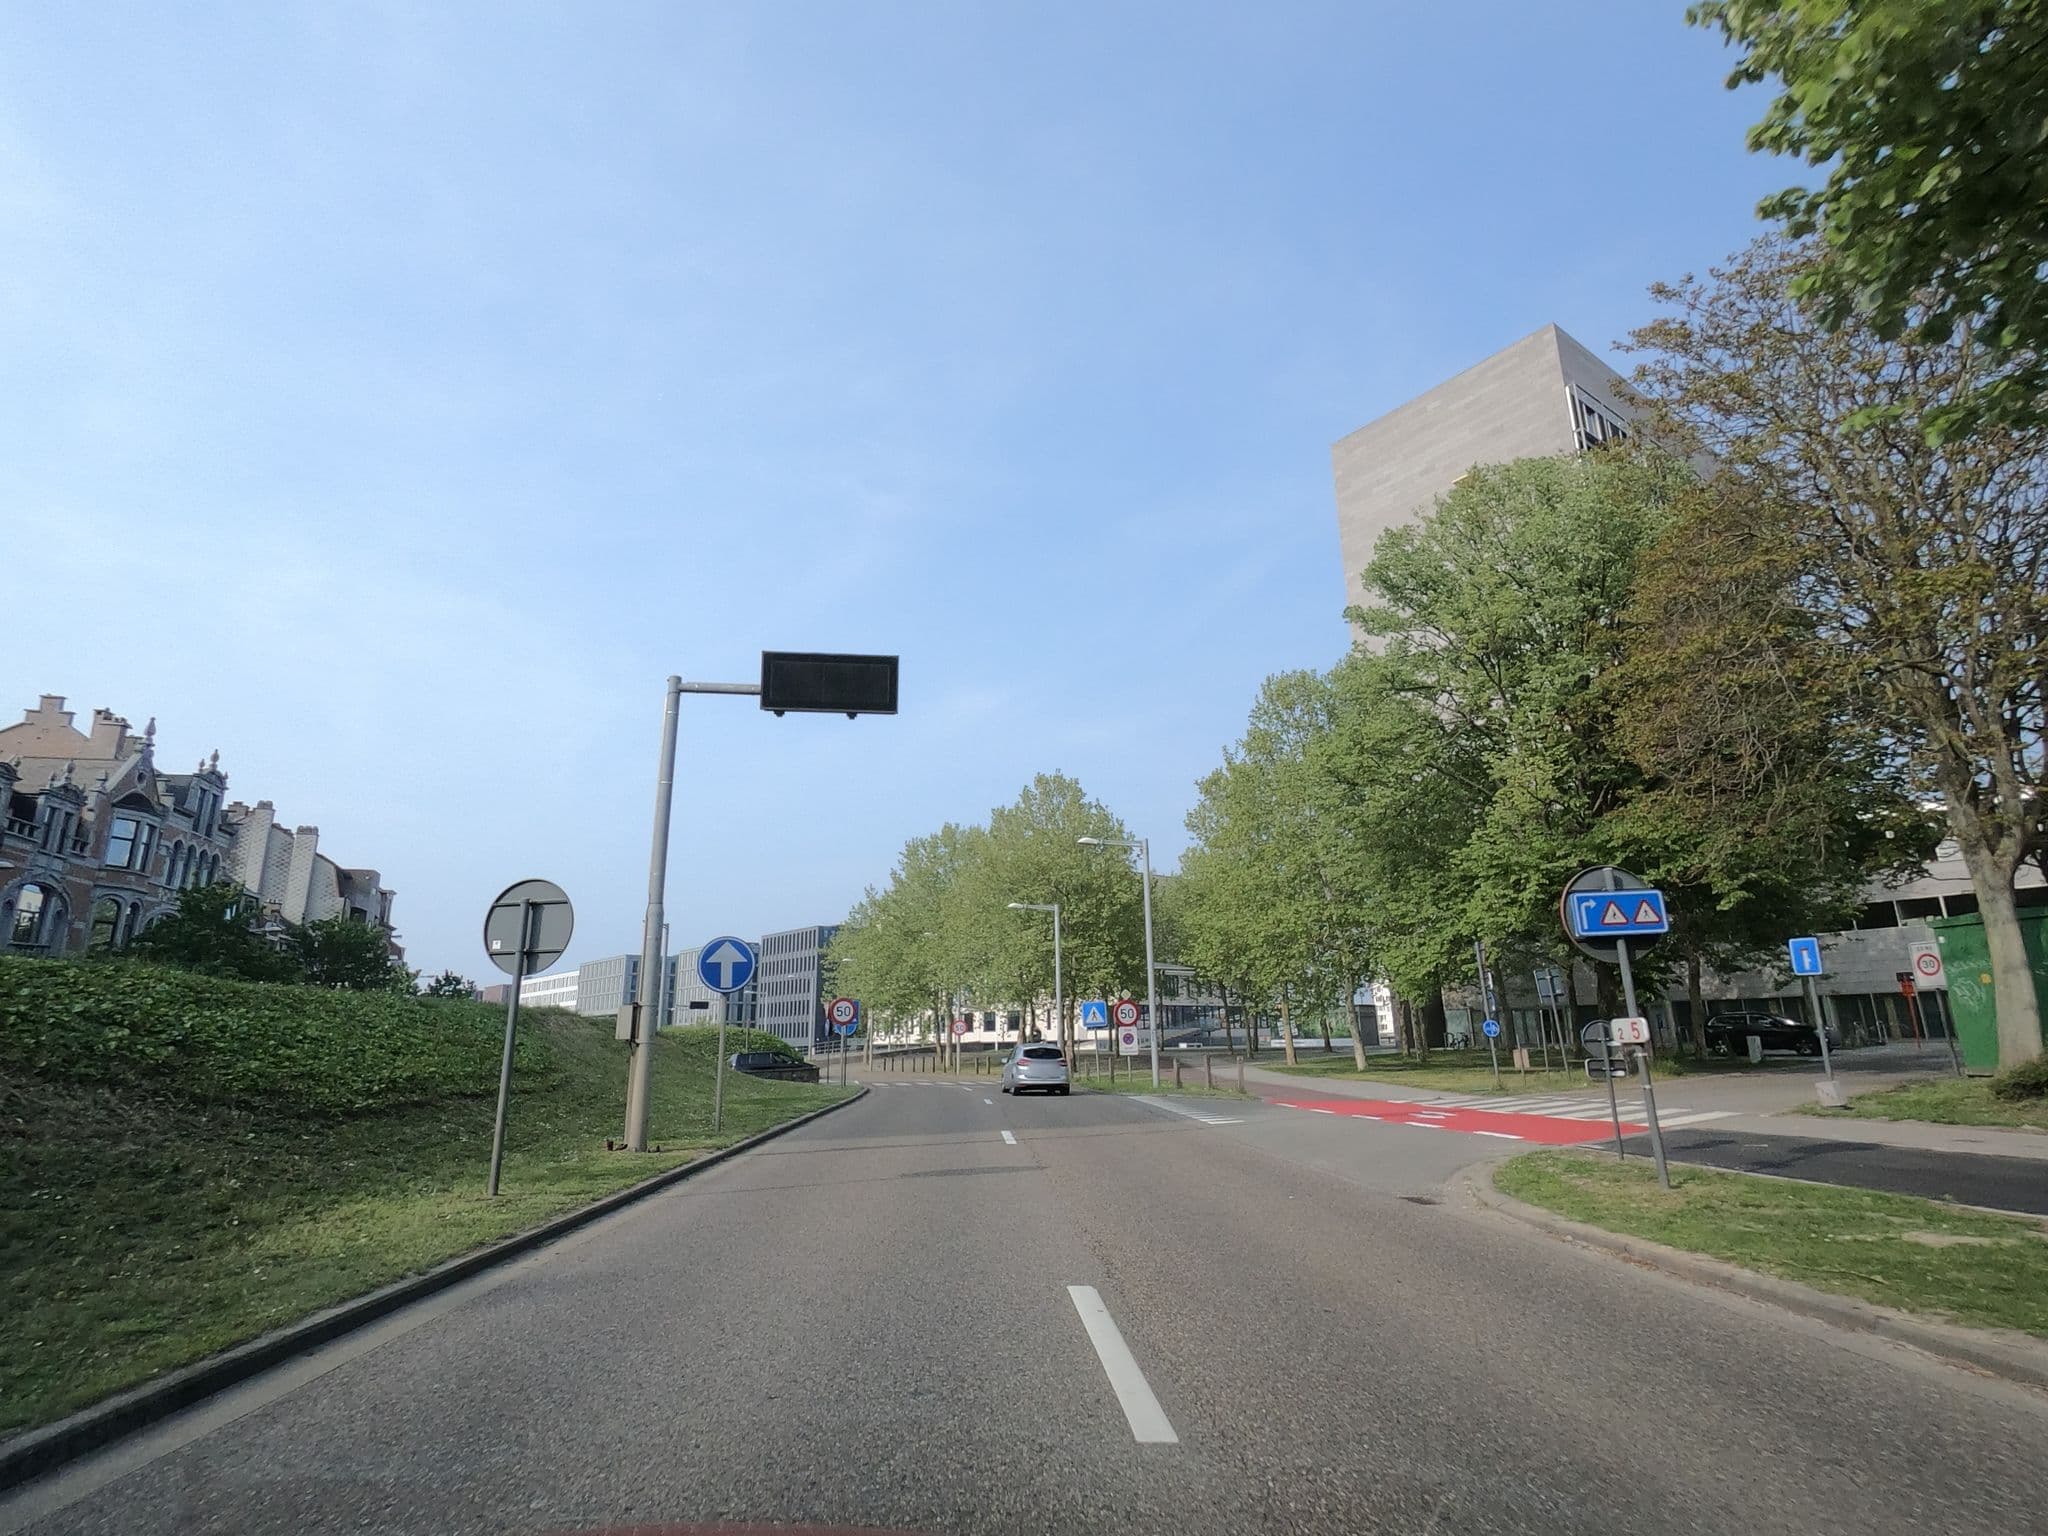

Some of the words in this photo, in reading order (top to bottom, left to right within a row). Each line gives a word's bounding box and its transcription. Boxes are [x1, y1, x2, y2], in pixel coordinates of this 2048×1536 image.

[1922, 960, 1935, 969] 30
[836, 1006, 851, 1017] 50
[1120, 1008, 1135, 1019] 50
[1617, 1027, 1625, 1040] 2
[1630, 1021, 1640, 1040] 5
